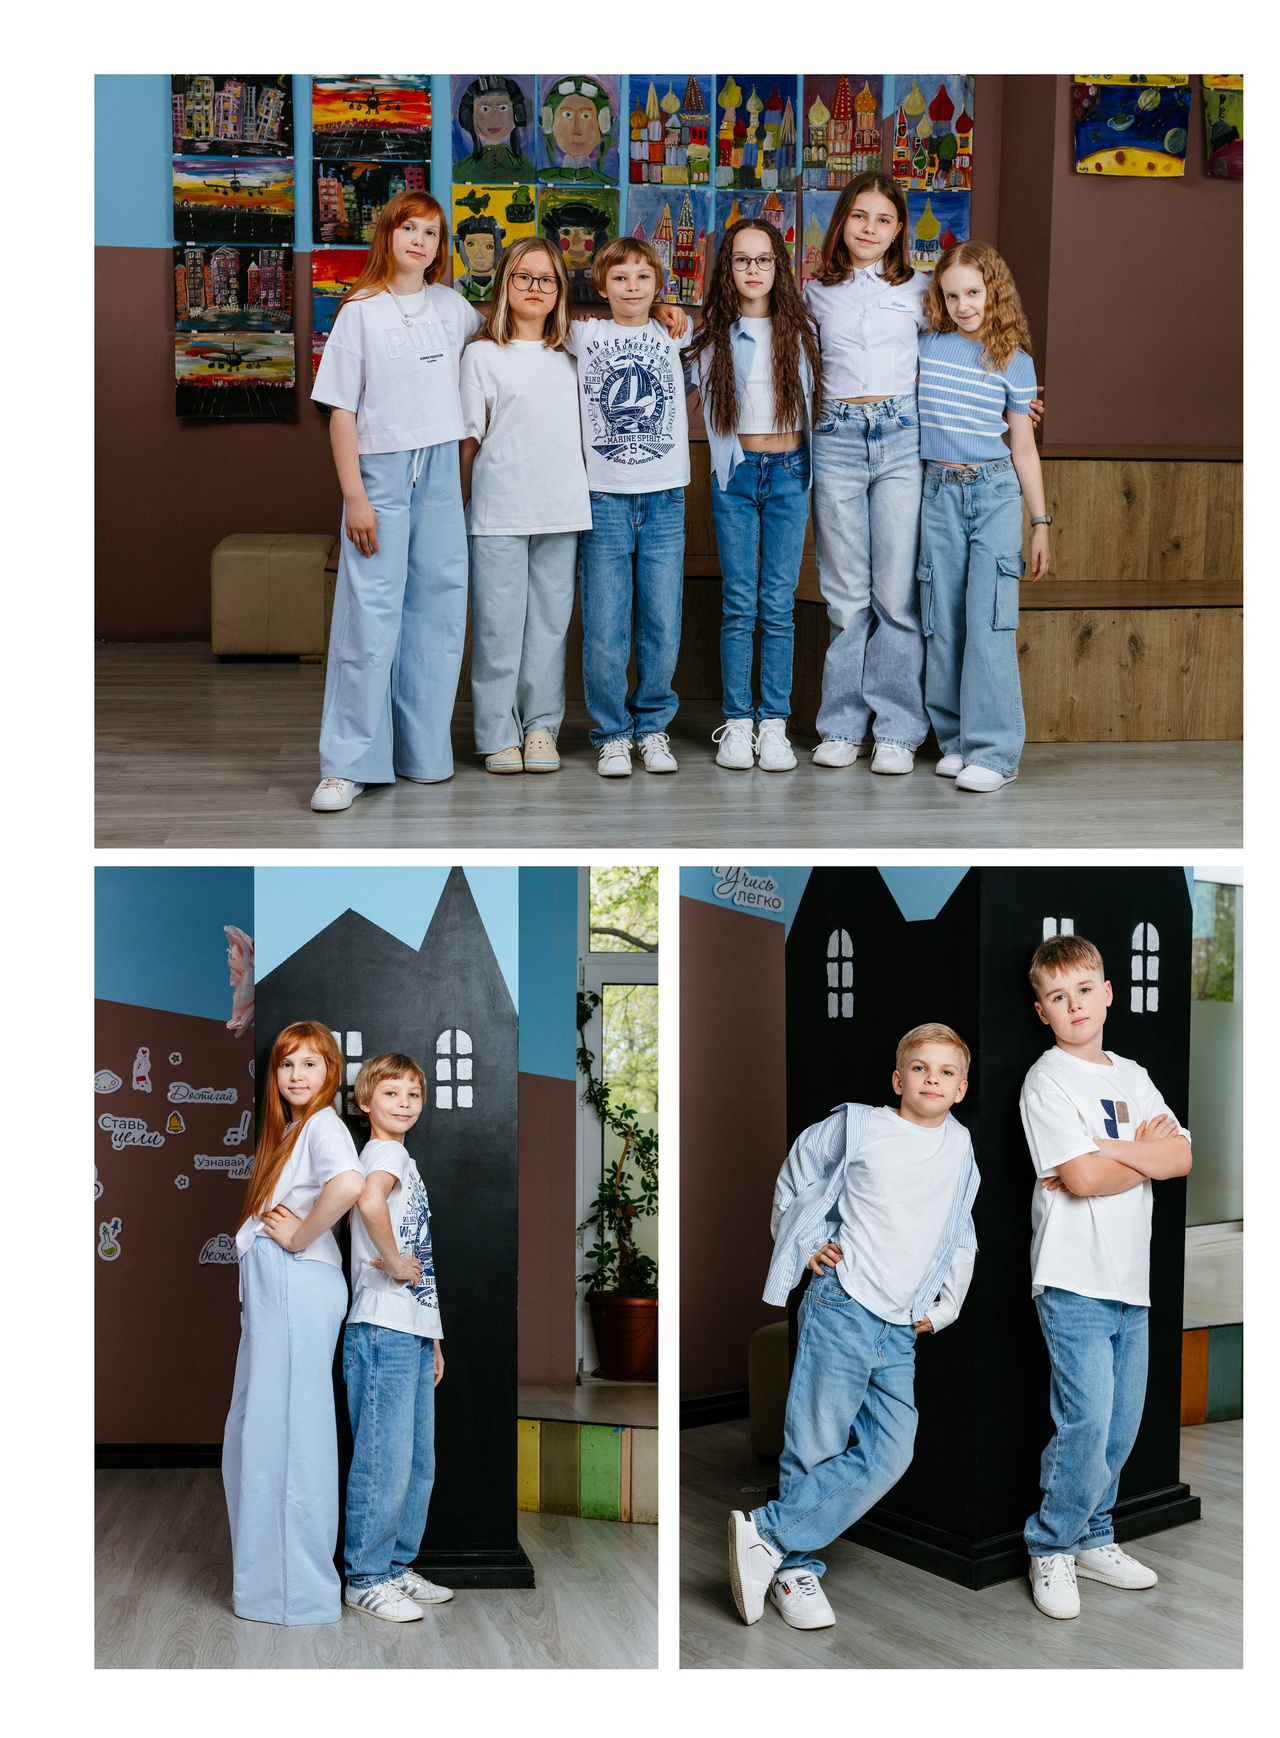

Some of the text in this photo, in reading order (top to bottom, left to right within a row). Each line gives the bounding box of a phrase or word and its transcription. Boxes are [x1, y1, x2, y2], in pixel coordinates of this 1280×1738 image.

[607, 434, 661, 444] MARINE SPIRIT
[627, 455, 655, 465] Dreams
[737, 890, 782, 909] легко
[170, 1084, 236, 1101] Достигай
[101, 1116, 146, 1129] Ставь
[113, 1131, 163, 1148] цели
[197, 1157, 245, 1168] Узнавай
[231, 1158, 254, 1176] нов
[218, 1236, 237, 1250] Бу
